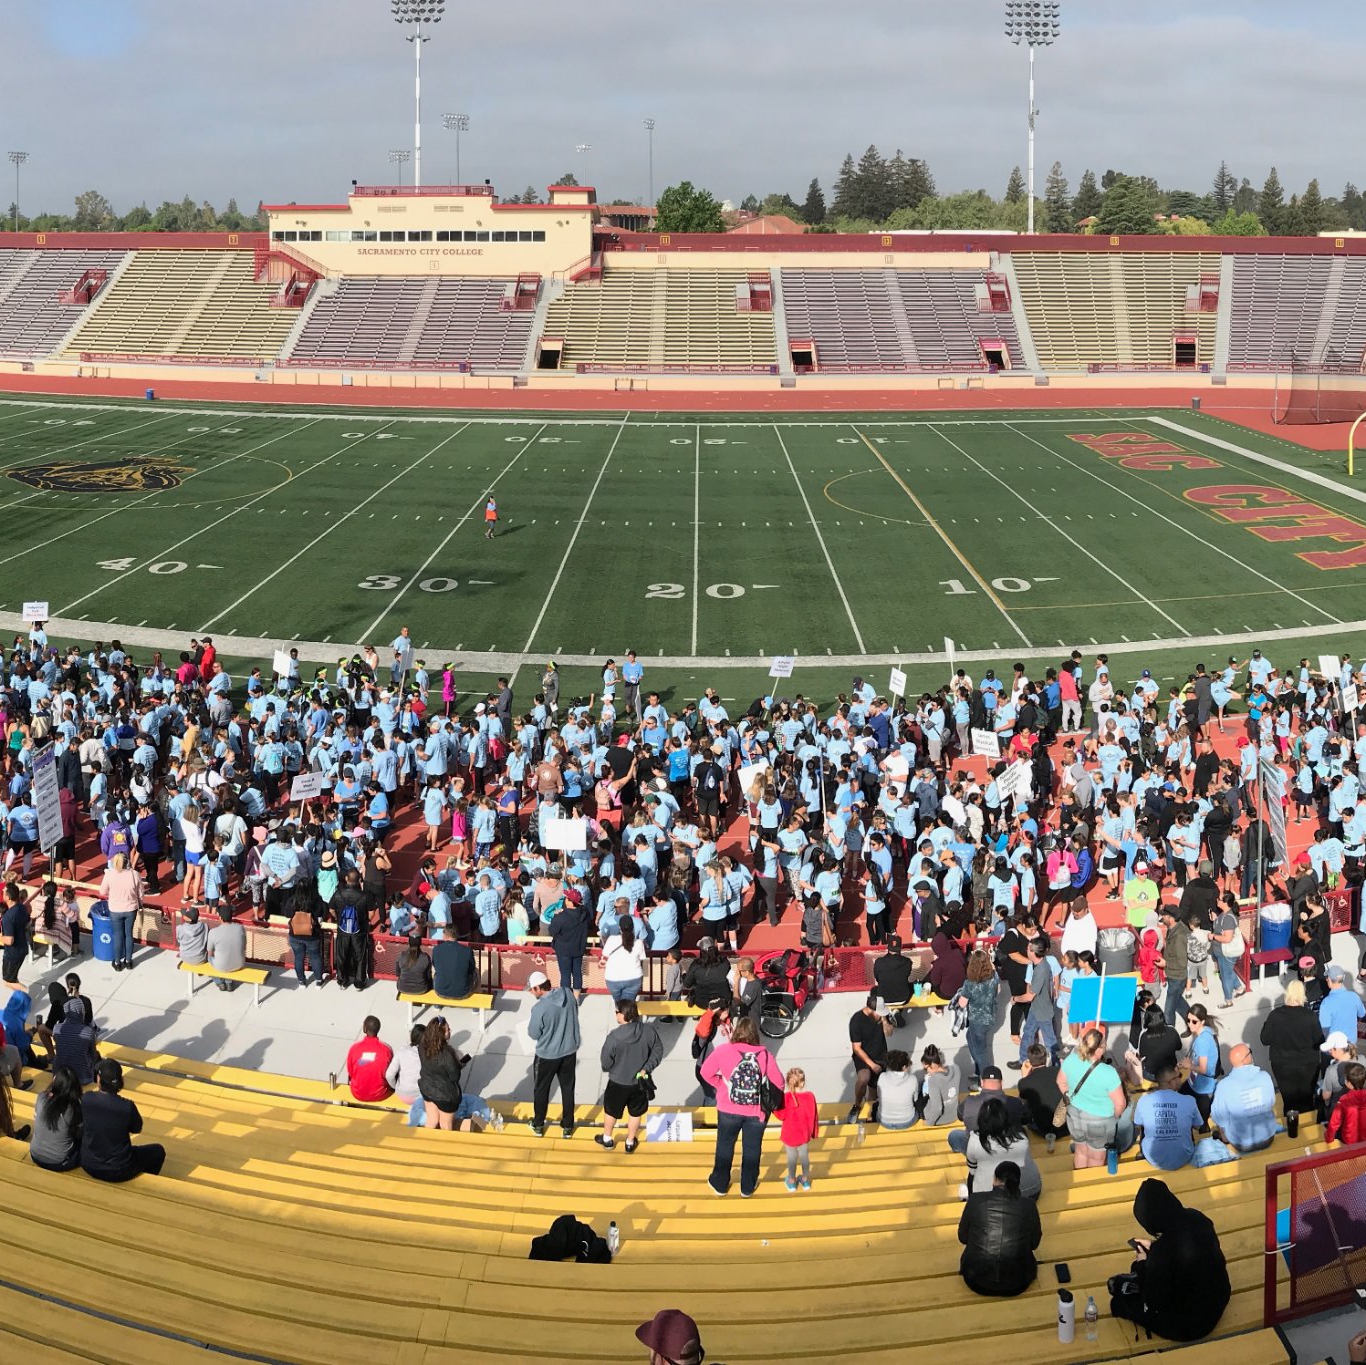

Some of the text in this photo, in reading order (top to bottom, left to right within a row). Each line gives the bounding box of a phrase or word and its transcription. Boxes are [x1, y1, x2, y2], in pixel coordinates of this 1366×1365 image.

[357, 248, 484, 256] SACRAMENTO CITY COLLEGE
[1065, 432, 1225, 471] SAC
[95, 557, 188, 575] 40
[357, 574, 459, 593] 30
[644, 582, 746, 599] 20
[938, 577, 1032, 595] 10
[1154, 1109, 1178, 1118] CAPITAL
